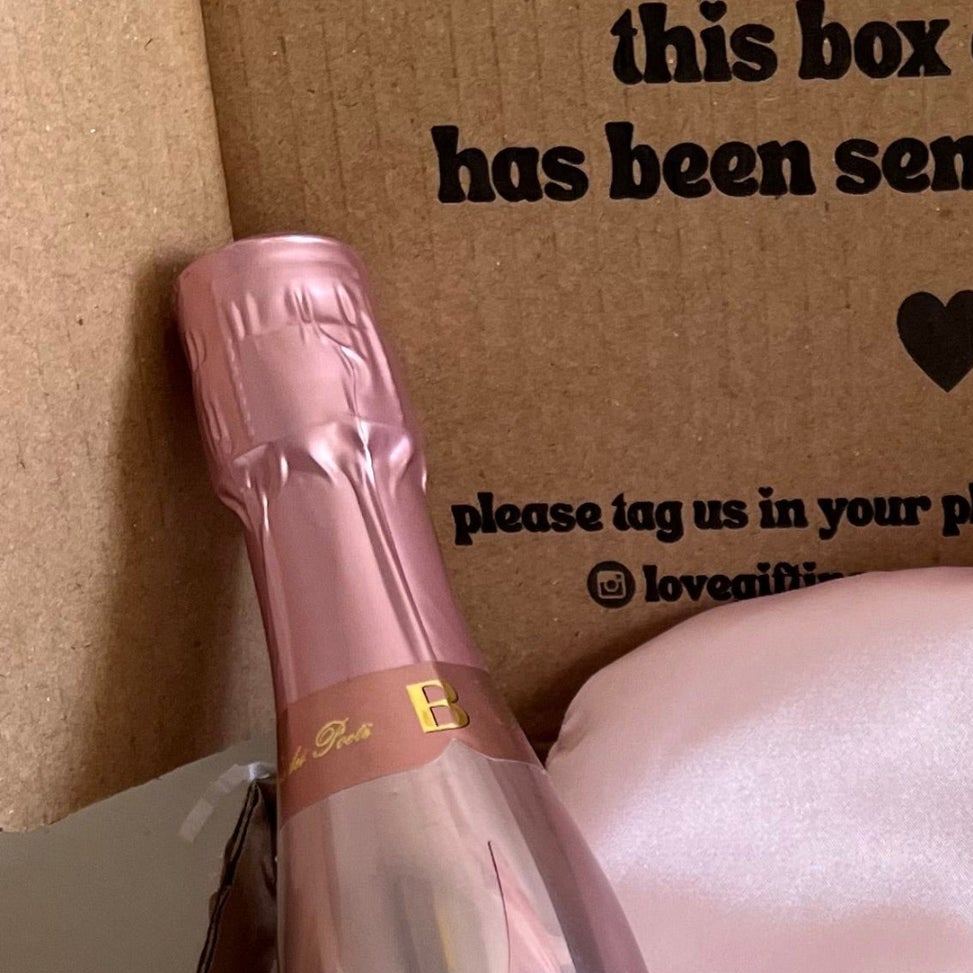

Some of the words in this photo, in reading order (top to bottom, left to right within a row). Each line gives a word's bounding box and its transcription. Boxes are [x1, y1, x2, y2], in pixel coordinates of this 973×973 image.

[611, 0, 777, 84] this
[796, 0, 951, 79] box
[431, 125, 588, 203] has
[605, 122, 816, 199] been
[451, 492, 603, 546] please
[612, 493, 683, 543] tag
[692, 500, 748, 529] us
[758, 487, 808, 528] in
[818, 496, 931, 540] your
